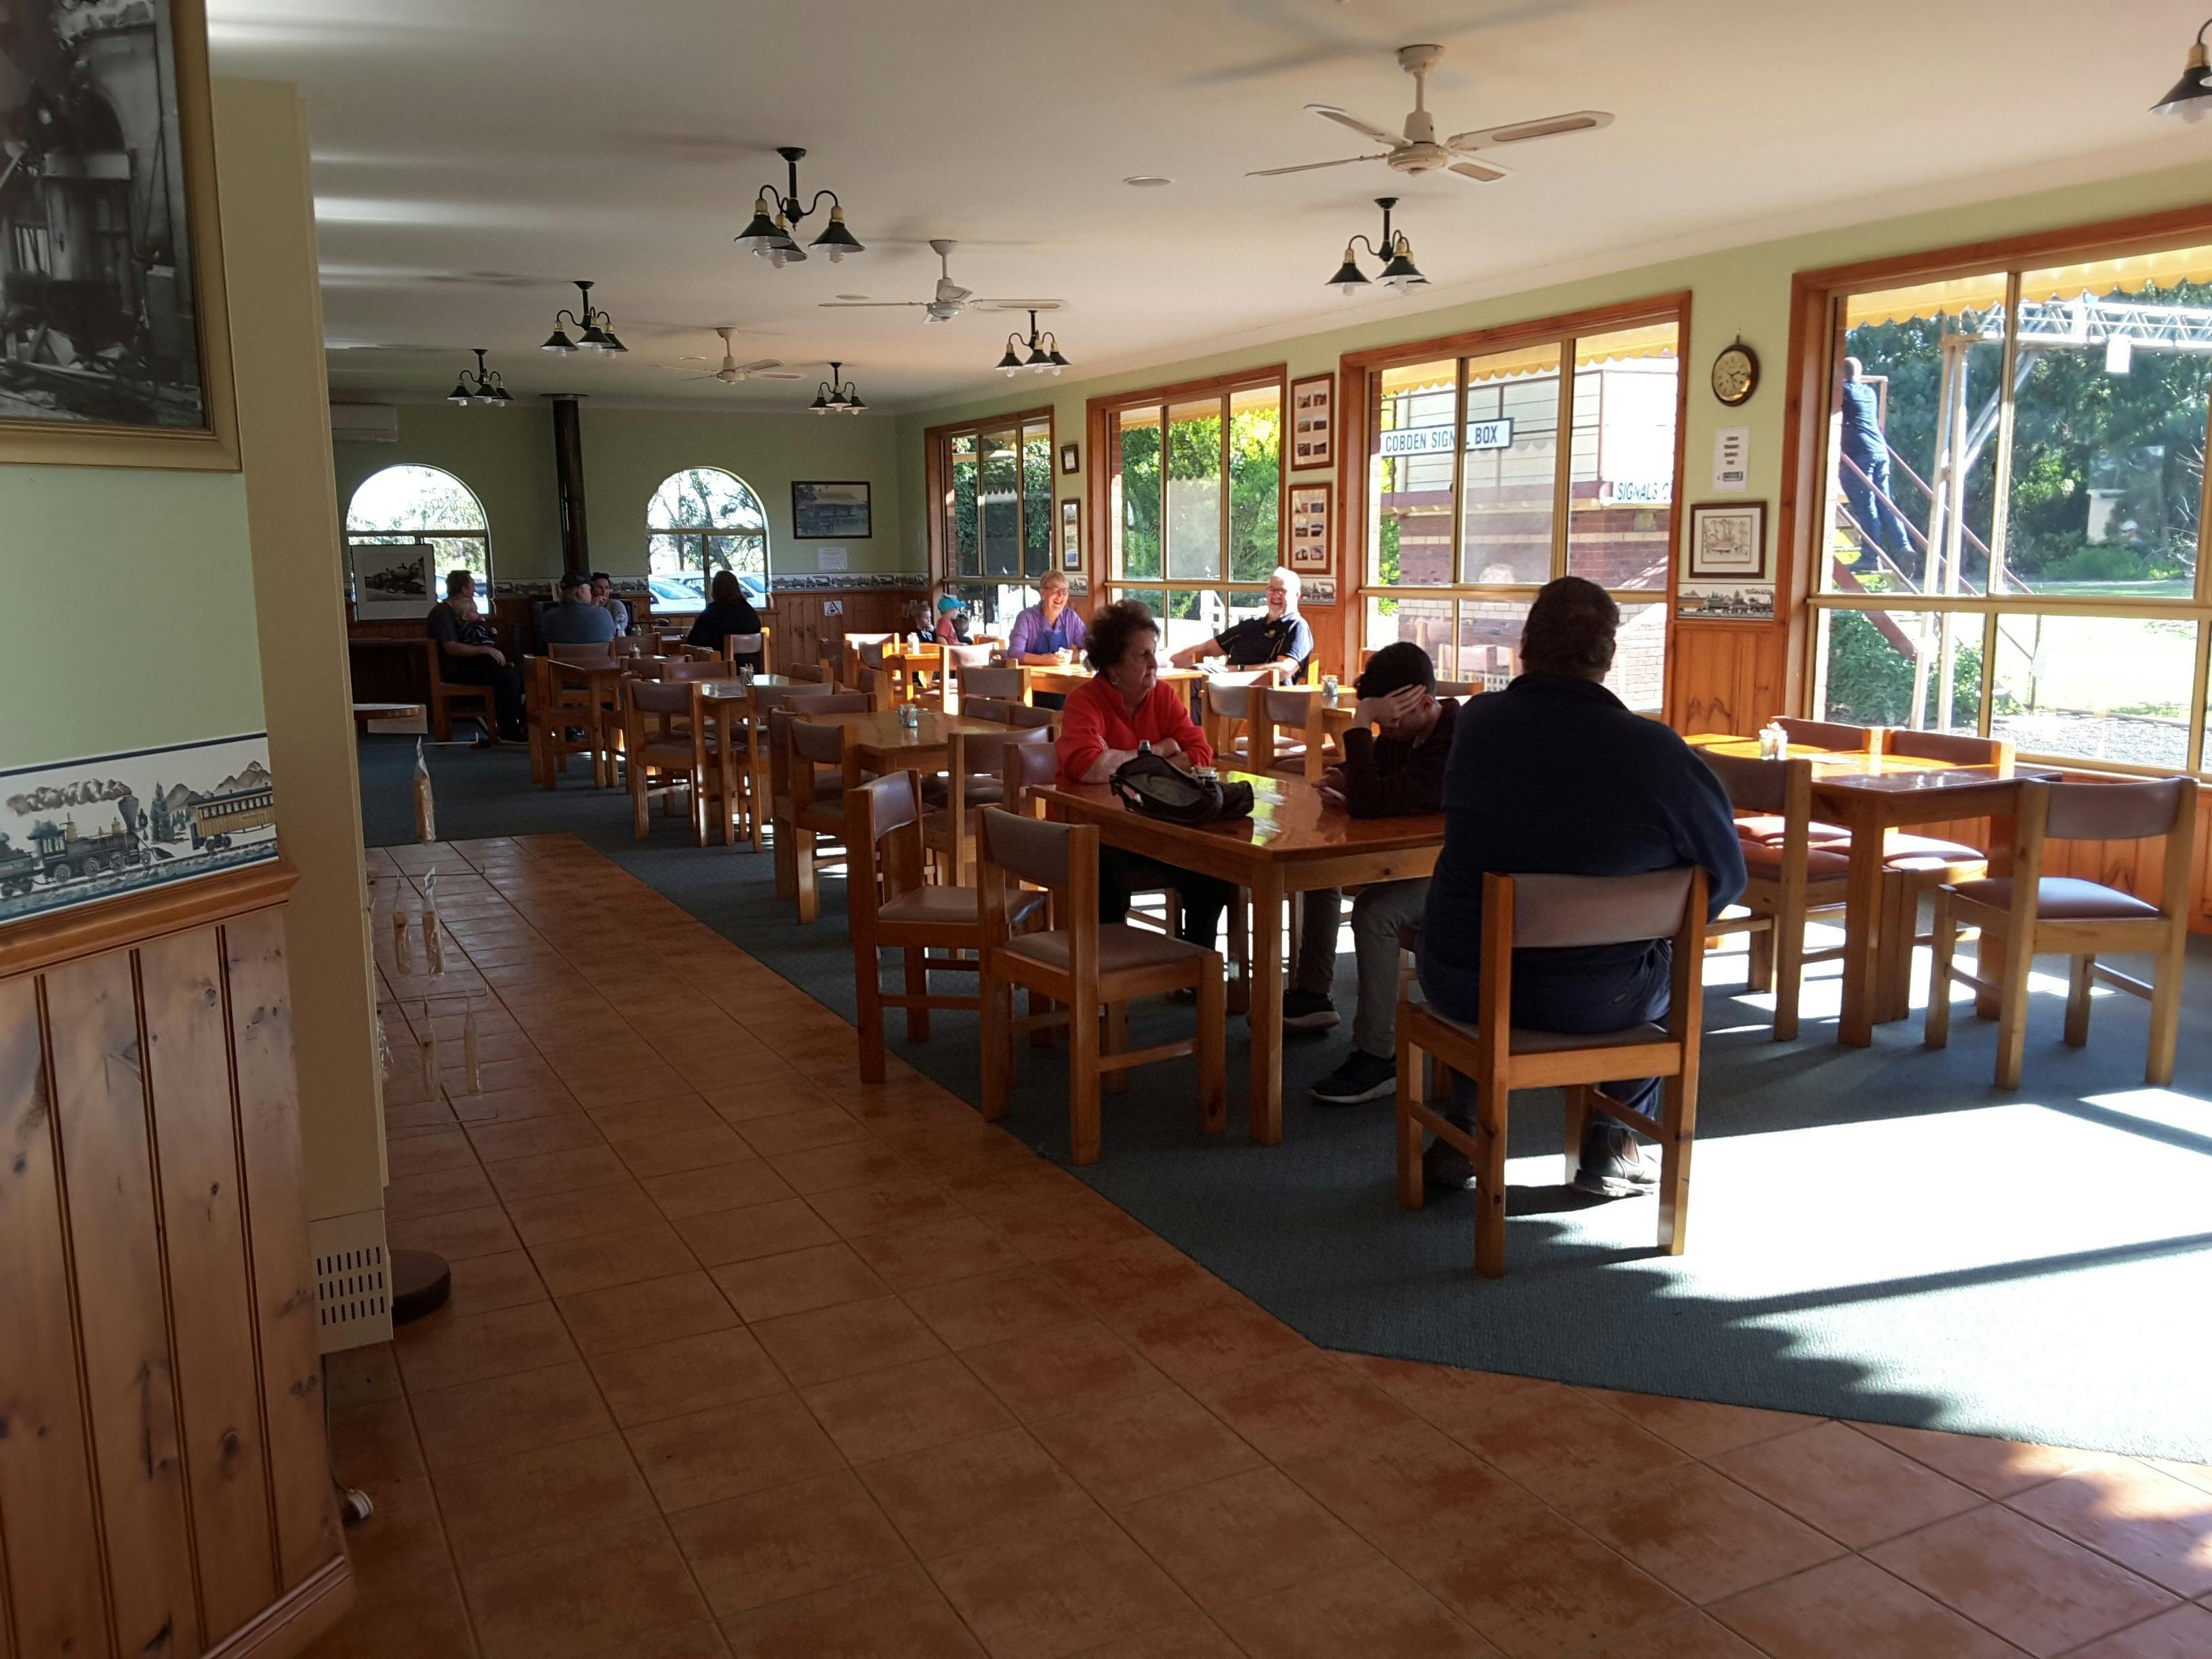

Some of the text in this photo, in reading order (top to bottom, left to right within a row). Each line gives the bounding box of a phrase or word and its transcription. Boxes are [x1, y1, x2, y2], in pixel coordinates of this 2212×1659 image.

[1385, 425, 1498, 452] COBDEN SIGN BOX
[1617, 482, 1658, 500] SIGNALS
